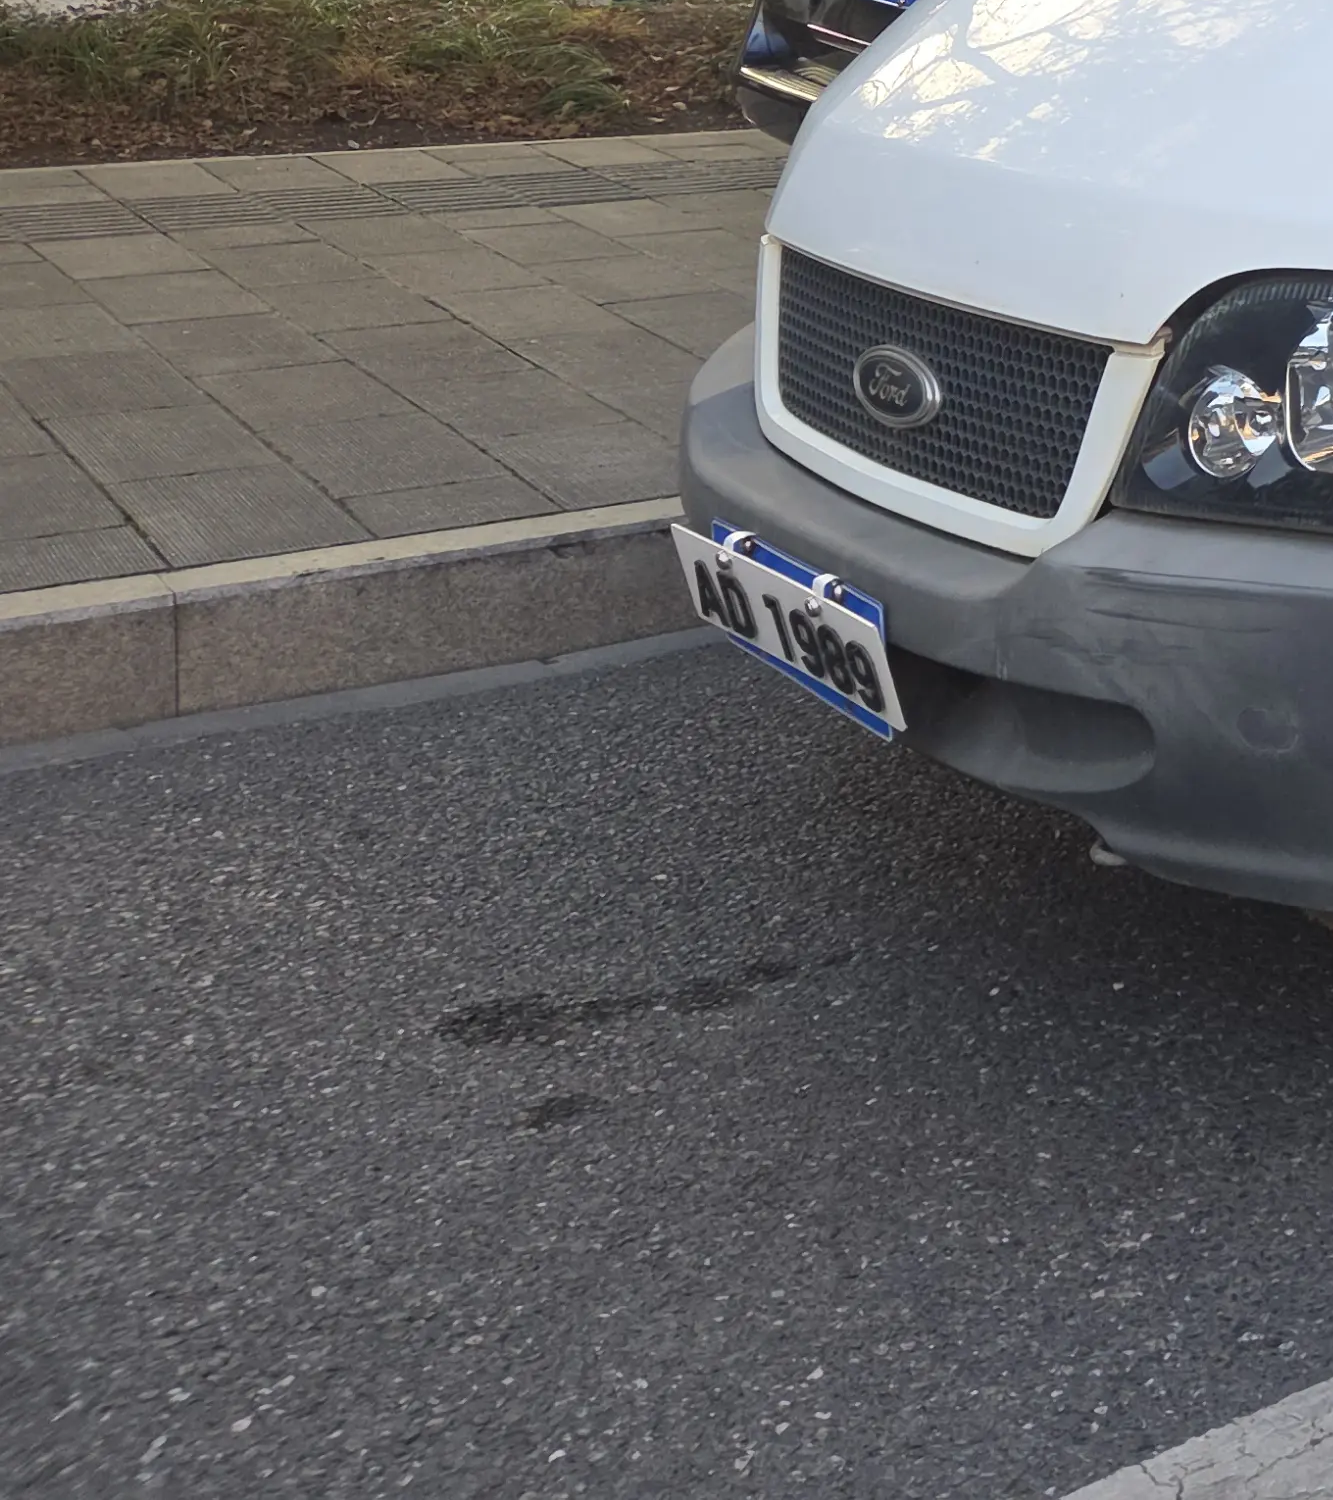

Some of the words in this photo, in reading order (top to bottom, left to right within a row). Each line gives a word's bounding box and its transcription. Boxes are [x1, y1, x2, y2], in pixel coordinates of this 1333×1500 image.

[868, 362, 912, 407] Ford
[694, 559, 758, 640] AD
[761, 593, 886, 714] 1989
